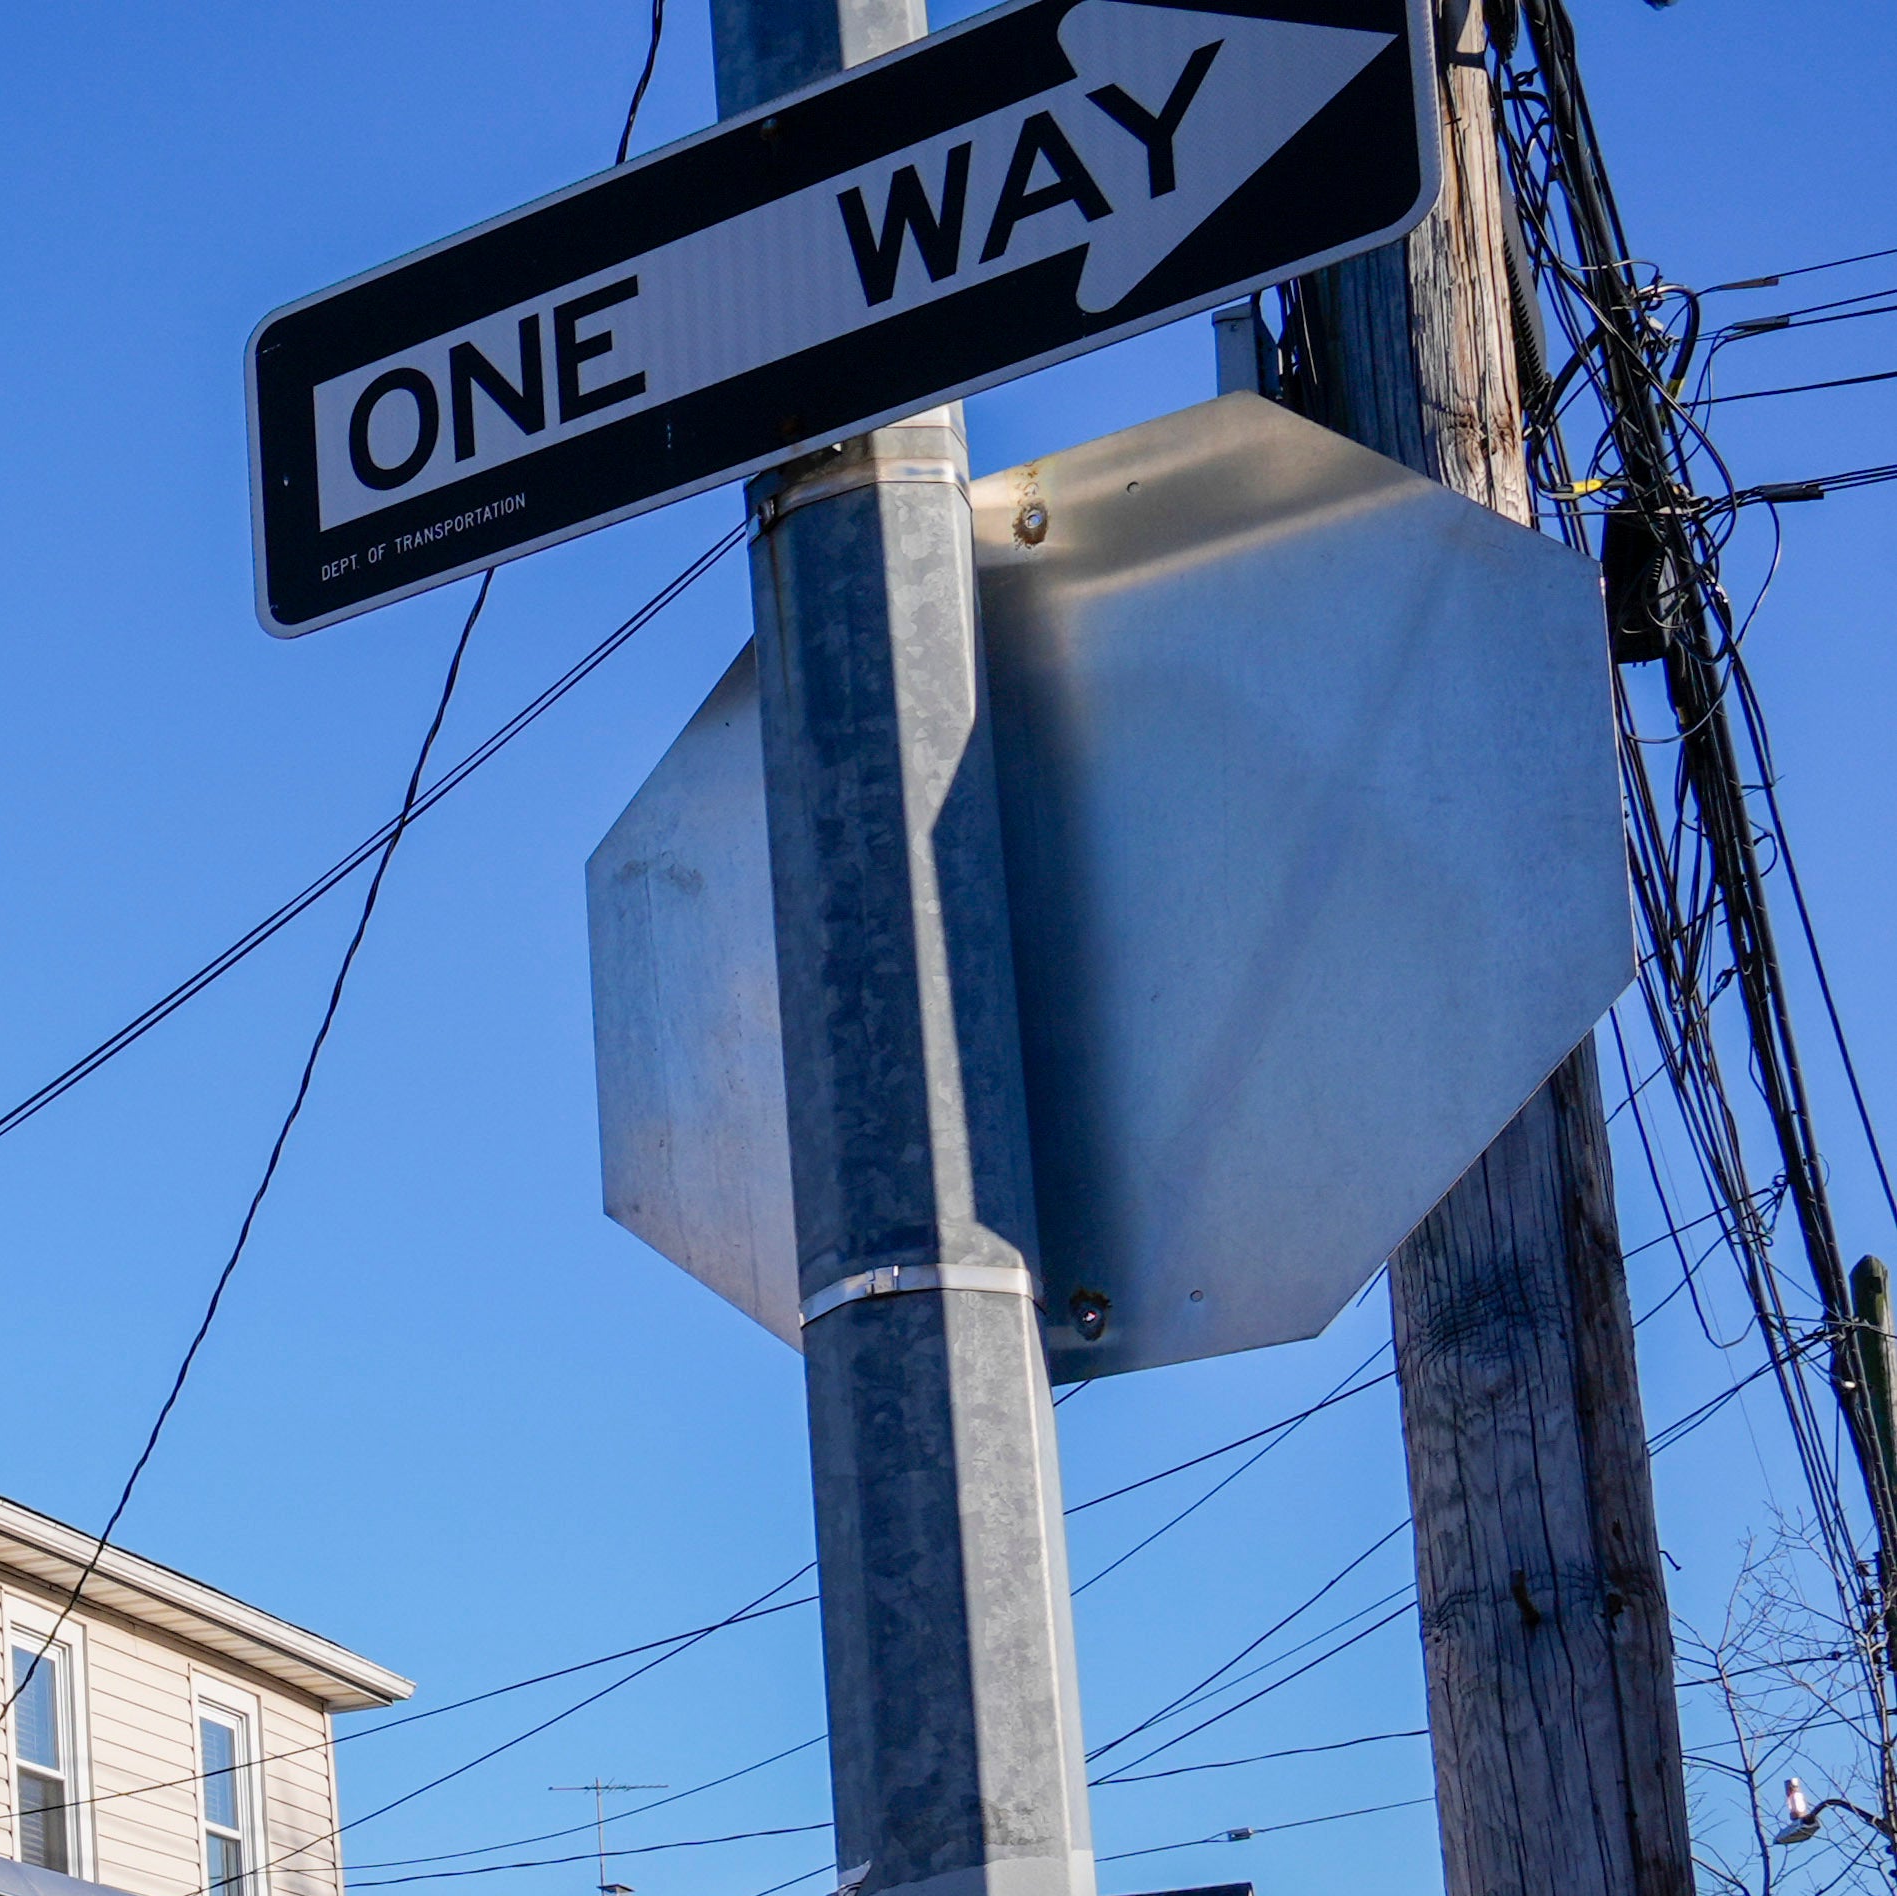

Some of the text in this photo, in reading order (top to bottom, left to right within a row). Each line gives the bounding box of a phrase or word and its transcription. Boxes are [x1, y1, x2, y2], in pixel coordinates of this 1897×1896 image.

[348, 40, 1225, 491] ONE WAY
[321, 493, 526, 581] DEPT. OF TRANSPORTATION
